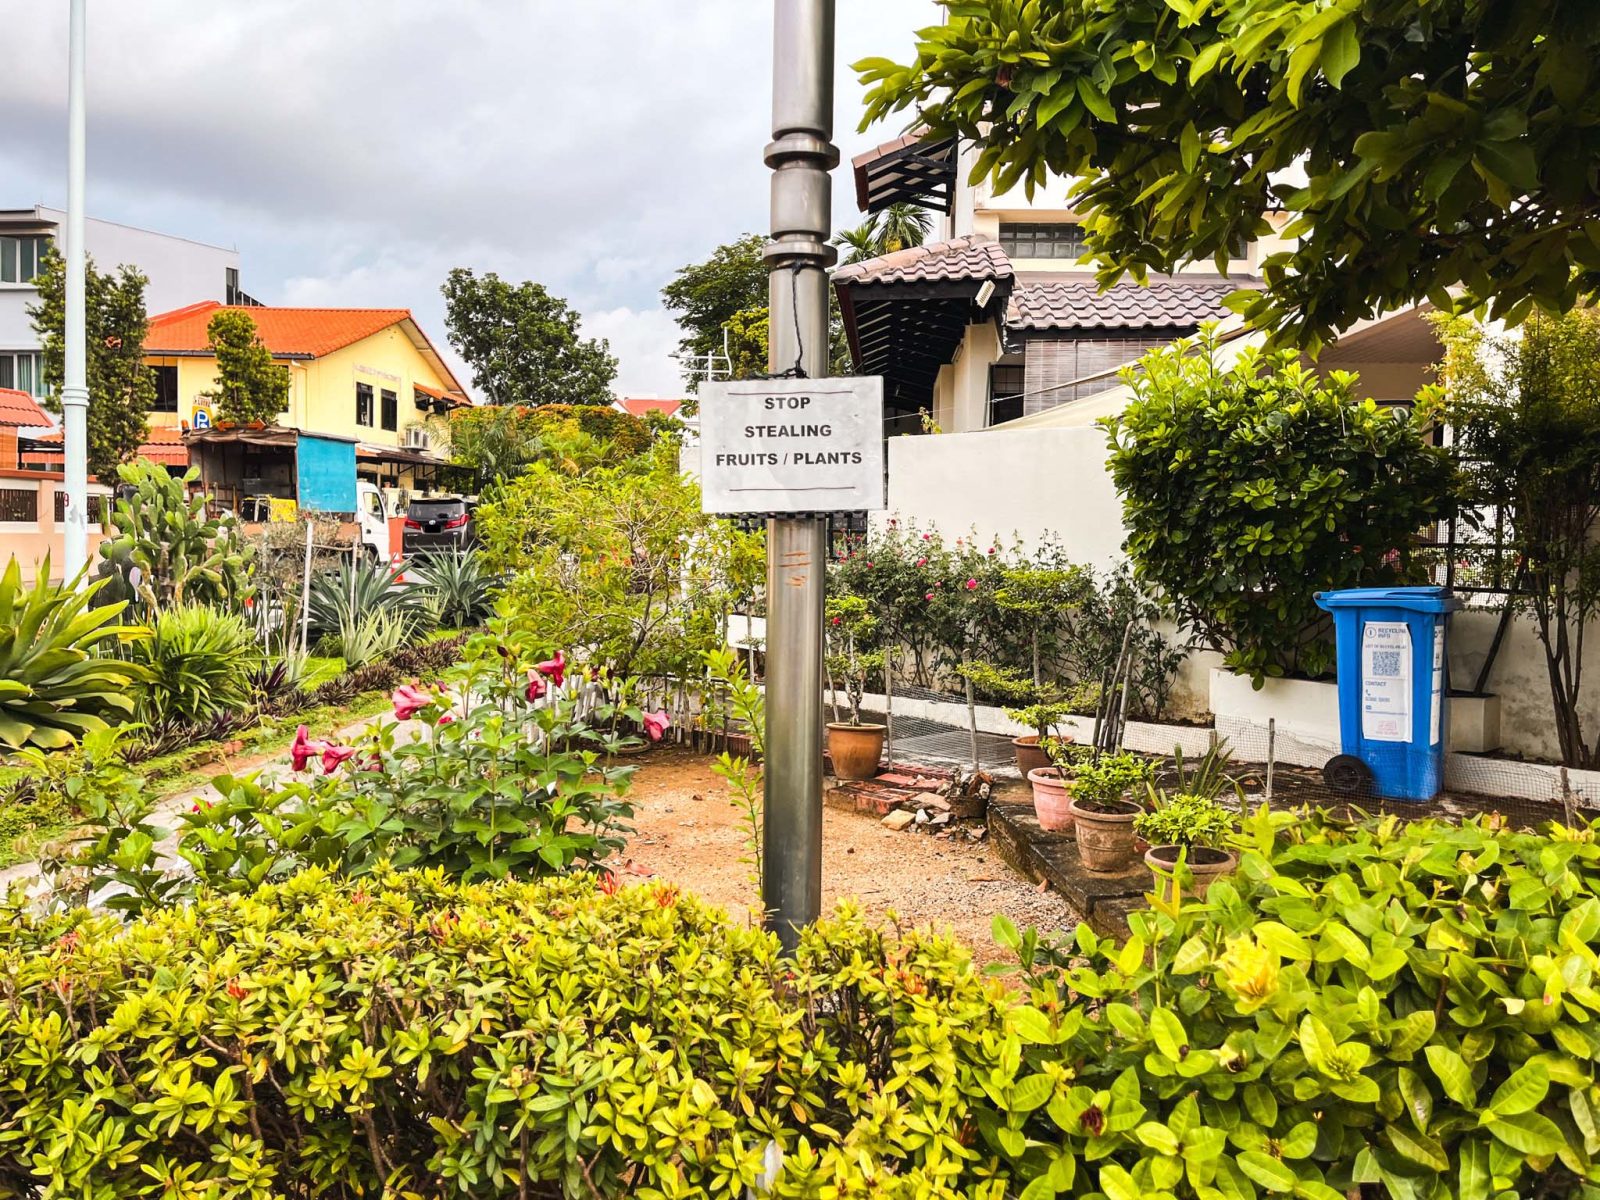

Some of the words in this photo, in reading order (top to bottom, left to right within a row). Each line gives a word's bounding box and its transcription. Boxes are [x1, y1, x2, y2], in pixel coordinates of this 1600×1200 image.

[764, 397, 811, 410] STOP
[744, 425, 832, 438] STEALING
[716, 453, 778, 466] FRUITS
[783, 453, 788, 465] /
[793, 452, 862, 465] PLANTS
